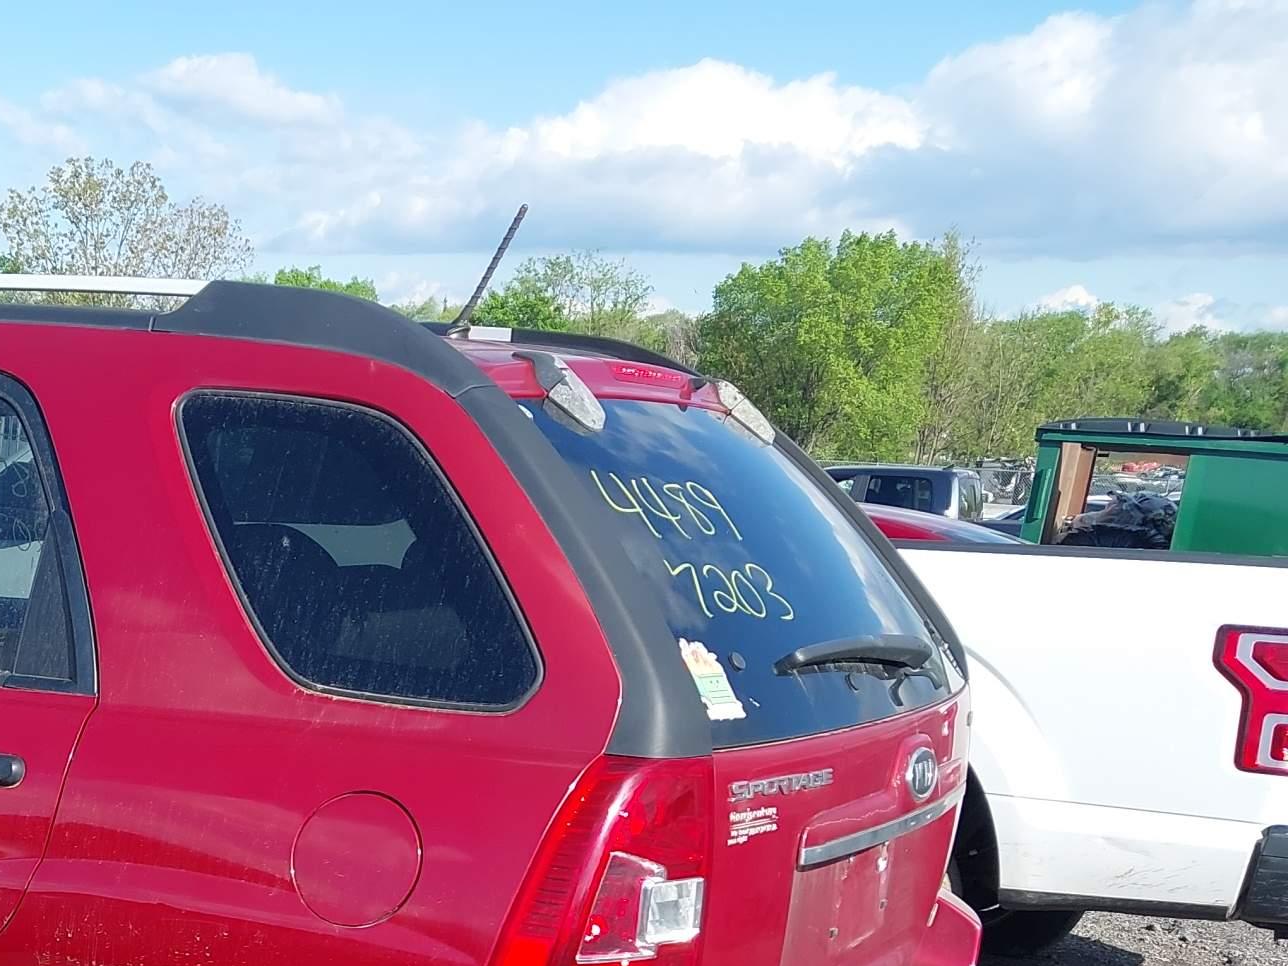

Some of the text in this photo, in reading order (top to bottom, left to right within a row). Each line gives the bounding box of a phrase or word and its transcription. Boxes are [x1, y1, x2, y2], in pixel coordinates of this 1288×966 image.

[590, 469, 743, 541] 4489
[663, 558, 795, 620] 7203
[728, 768, 834, 802] SPORTAGE
